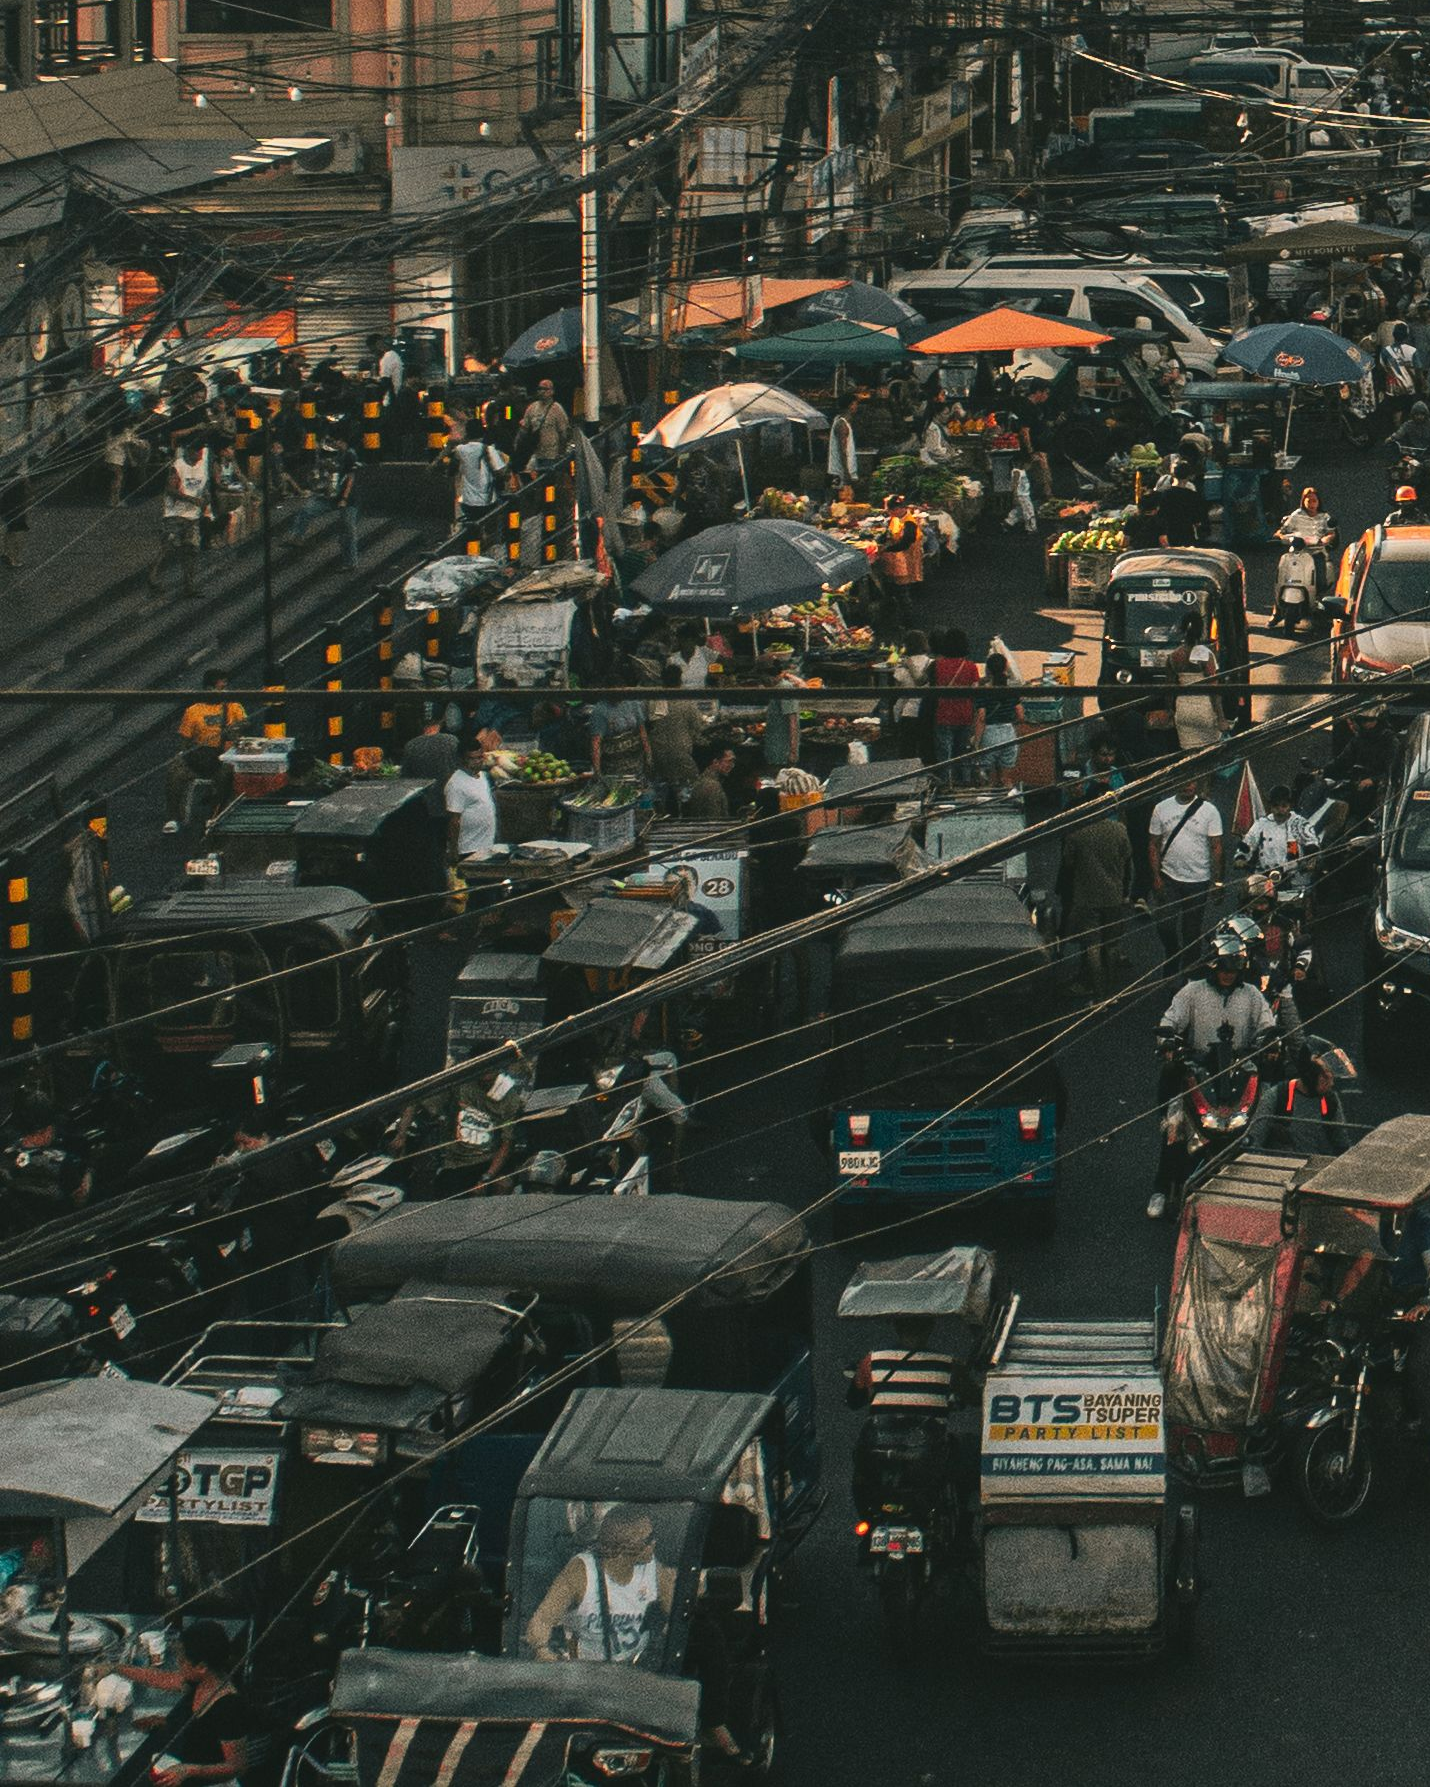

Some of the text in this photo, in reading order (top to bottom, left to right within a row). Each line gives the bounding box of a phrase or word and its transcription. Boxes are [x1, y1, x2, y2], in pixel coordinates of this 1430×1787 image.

[1294, 245, 1357, 256] MICROMATIC
[707, 879, 731, 896] 28
[989, 1393, 1163, 1424] BTS BAYANING
[1085, 1407, 1161, 1424] TSUPER
[1004, 1425, 1142, 1441] PARTY LIST
[992, 1457, 1044, 1472] BIYAHENG
[1100, 1457, 1131, 1471] SAMA
[192, 1463, 273, 1498] TGP
[141, 1497, 268, 1513] PARTYLIST
